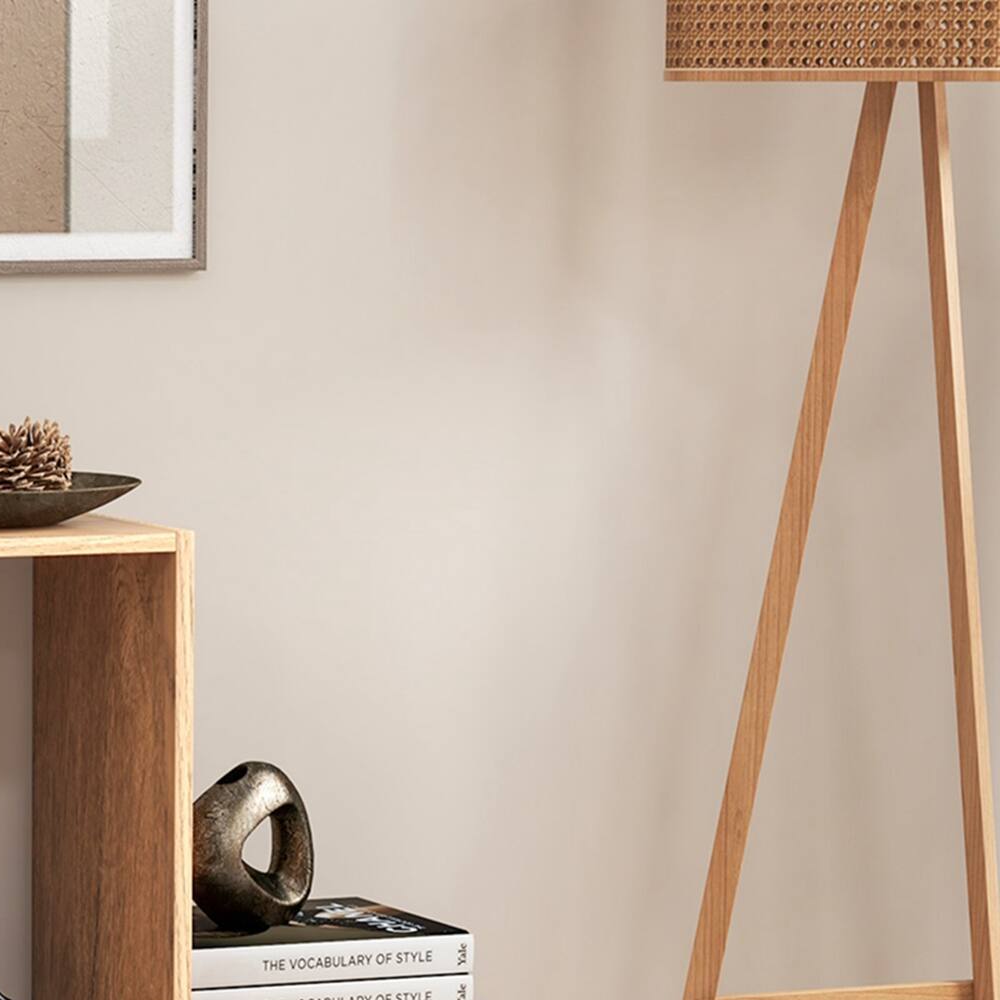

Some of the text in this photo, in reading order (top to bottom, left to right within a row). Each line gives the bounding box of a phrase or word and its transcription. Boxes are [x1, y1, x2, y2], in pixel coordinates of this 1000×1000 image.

[262, 950, 433, 972] THE VOCABULARY OF STYLE
[457, 943, 468, 966] Yale
